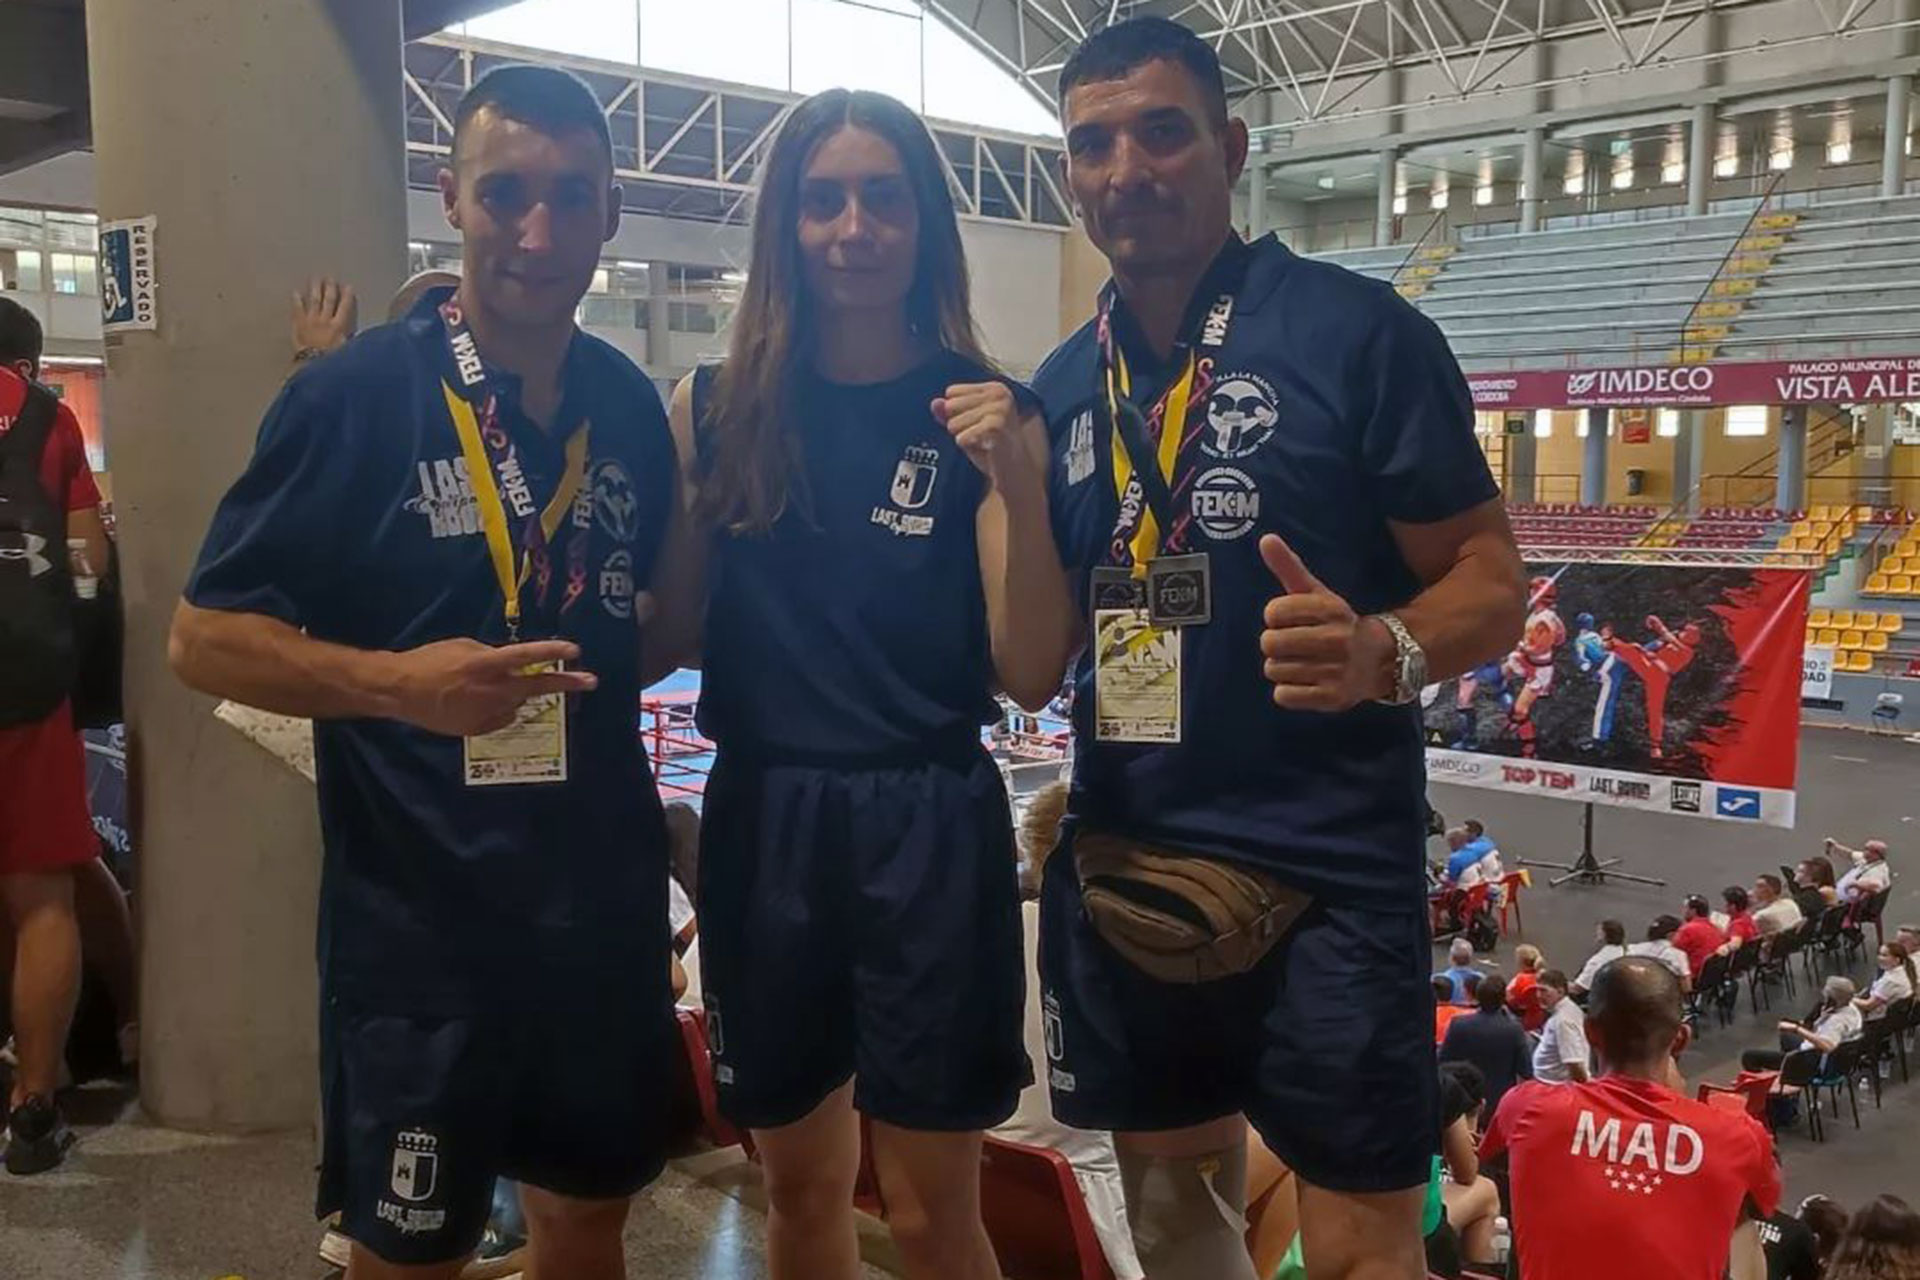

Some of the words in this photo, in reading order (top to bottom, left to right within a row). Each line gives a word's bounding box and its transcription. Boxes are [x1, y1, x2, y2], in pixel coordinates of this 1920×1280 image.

[133, 225, 151, 322] RESERVADO
[451, 331, 486, 386] FEKM
[1789, 362, 1839, 374] PALACIO
[1840, 359, 1905, 373] MUNICIPAL
[1599, 367, 1713, 393] IMDECO
[1776, 375, 1855, 400] VISTA
[497, 458, 536, 518] FEKM
[1502, 764, 1536, 784] TOP
[1538, 768, 1575, 790] TEN
[1589, 776, 1613, 795] LAST
[1571, 1110, 1703, 1175] MAD
